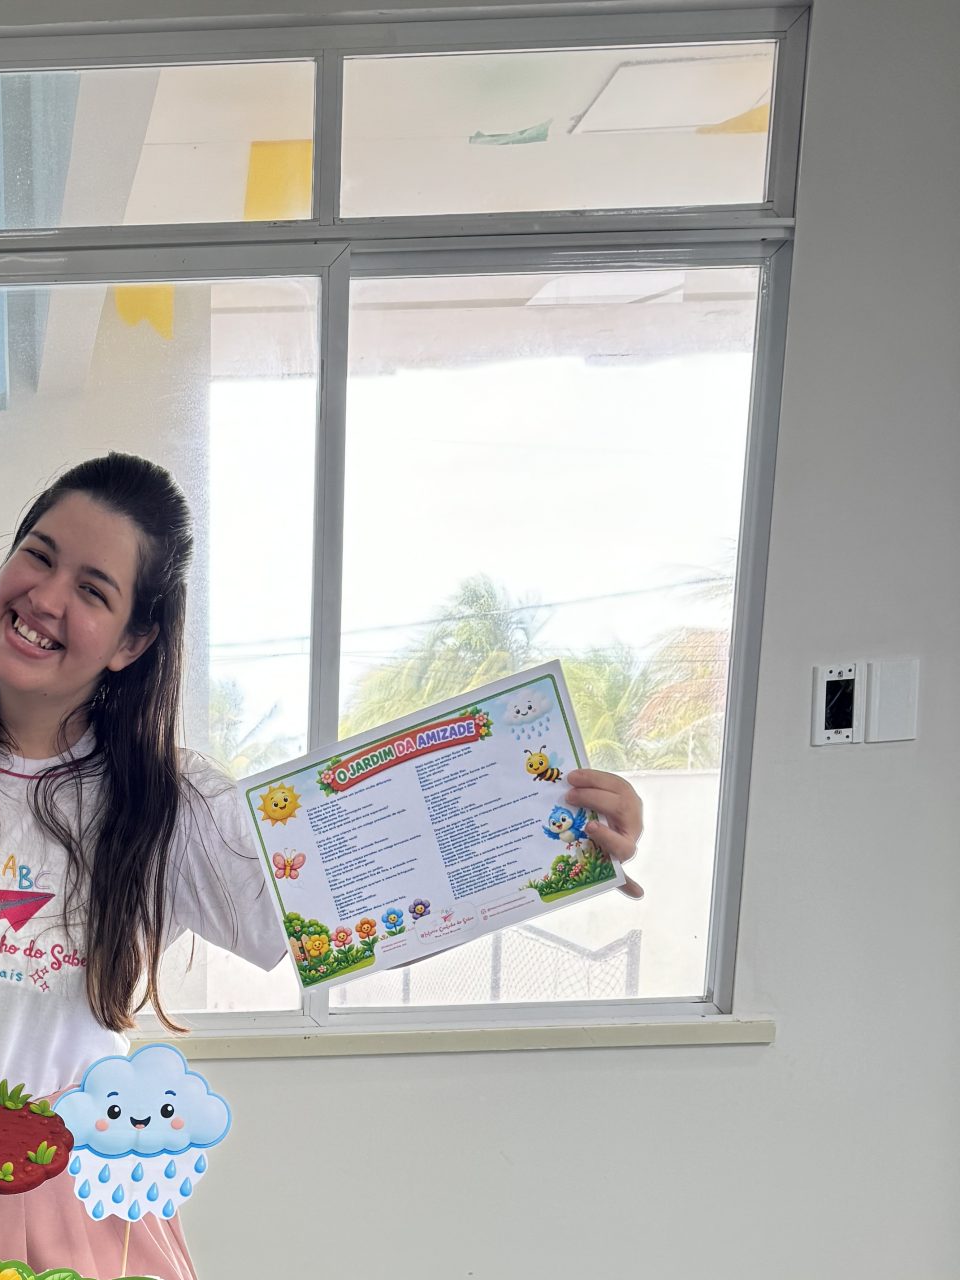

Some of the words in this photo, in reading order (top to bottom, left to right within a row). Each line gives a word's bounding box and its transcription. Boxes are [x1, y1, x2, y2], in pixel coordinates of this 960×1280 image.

[336, 770, 348, 783] O
[349, 746, 395, 778] JARDIM
[395, 739, 415, 756] DA
[417, 721, 475, 748] AMIZADE
[23, 938, 46, 959] do
[50, 943, 88, 970] Sabe
